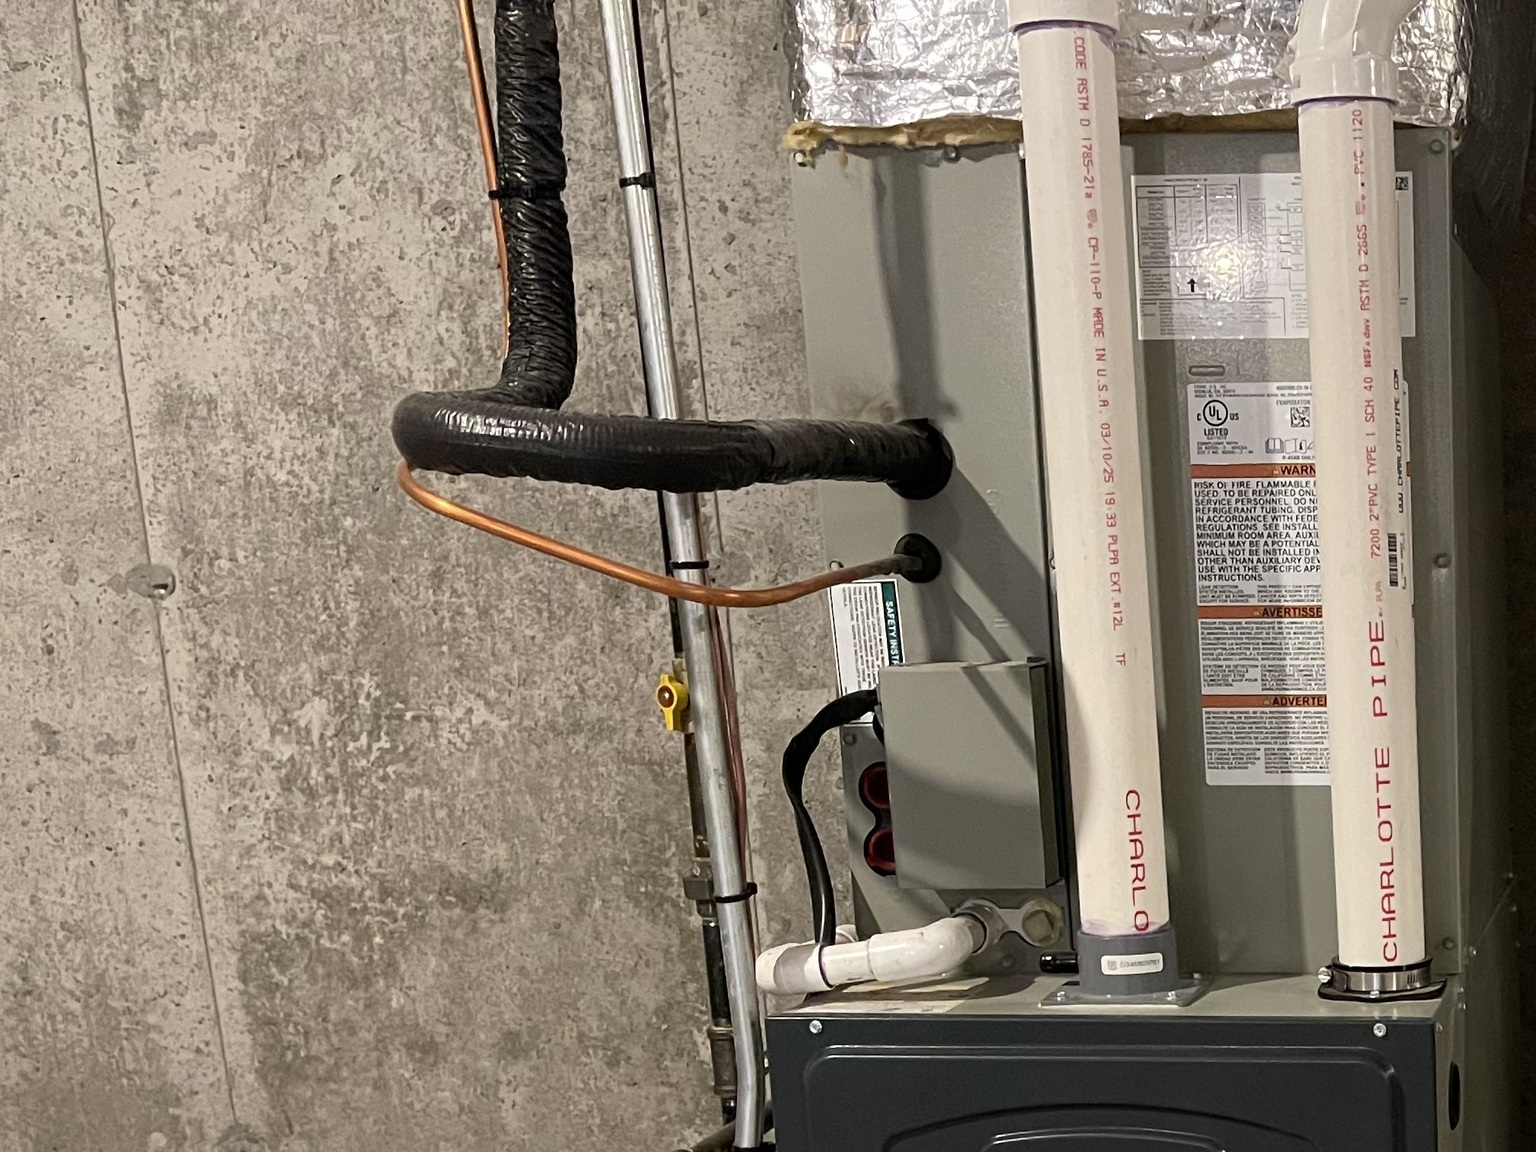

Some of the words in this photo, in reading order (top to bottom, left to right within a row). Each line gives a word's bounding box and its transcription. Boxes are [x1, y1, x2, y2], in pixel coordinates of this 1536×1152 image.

[1076, 78, 1090, 111] ASTM
[1352, 109, 1363, 140] 1120
[1356, 224, 1369, 256] 2665
[1359, 279, 1371, 311] ASTM
[1093, 307, 1105, 338] MADE
[1095, 347, 1107, 362] IN
[1363, 376, 1374, 391] 40
[1364, 399, 1376, 423] SCH
[1204, 428, 1229, 436] LISTED
[1100, 422, 1115, 483] 03/10/25
[1366, 445, 1377, 476] TYPE
[1196, 515, 1204, 523] IN
[1206, 515, 1268, 523] ACCORDANCE
[1107, 534, 1120, 566] PLPA
[1370, 528, 1381, 559] 7200
[1199, 574, 1265, 582] INSTRUCTIONS.
[885, 601, 897, 638] SAFETY
[1125, 789, 1149, 932] CHARLO
[1374, 746, 1398, 963] CHARLOTTE
